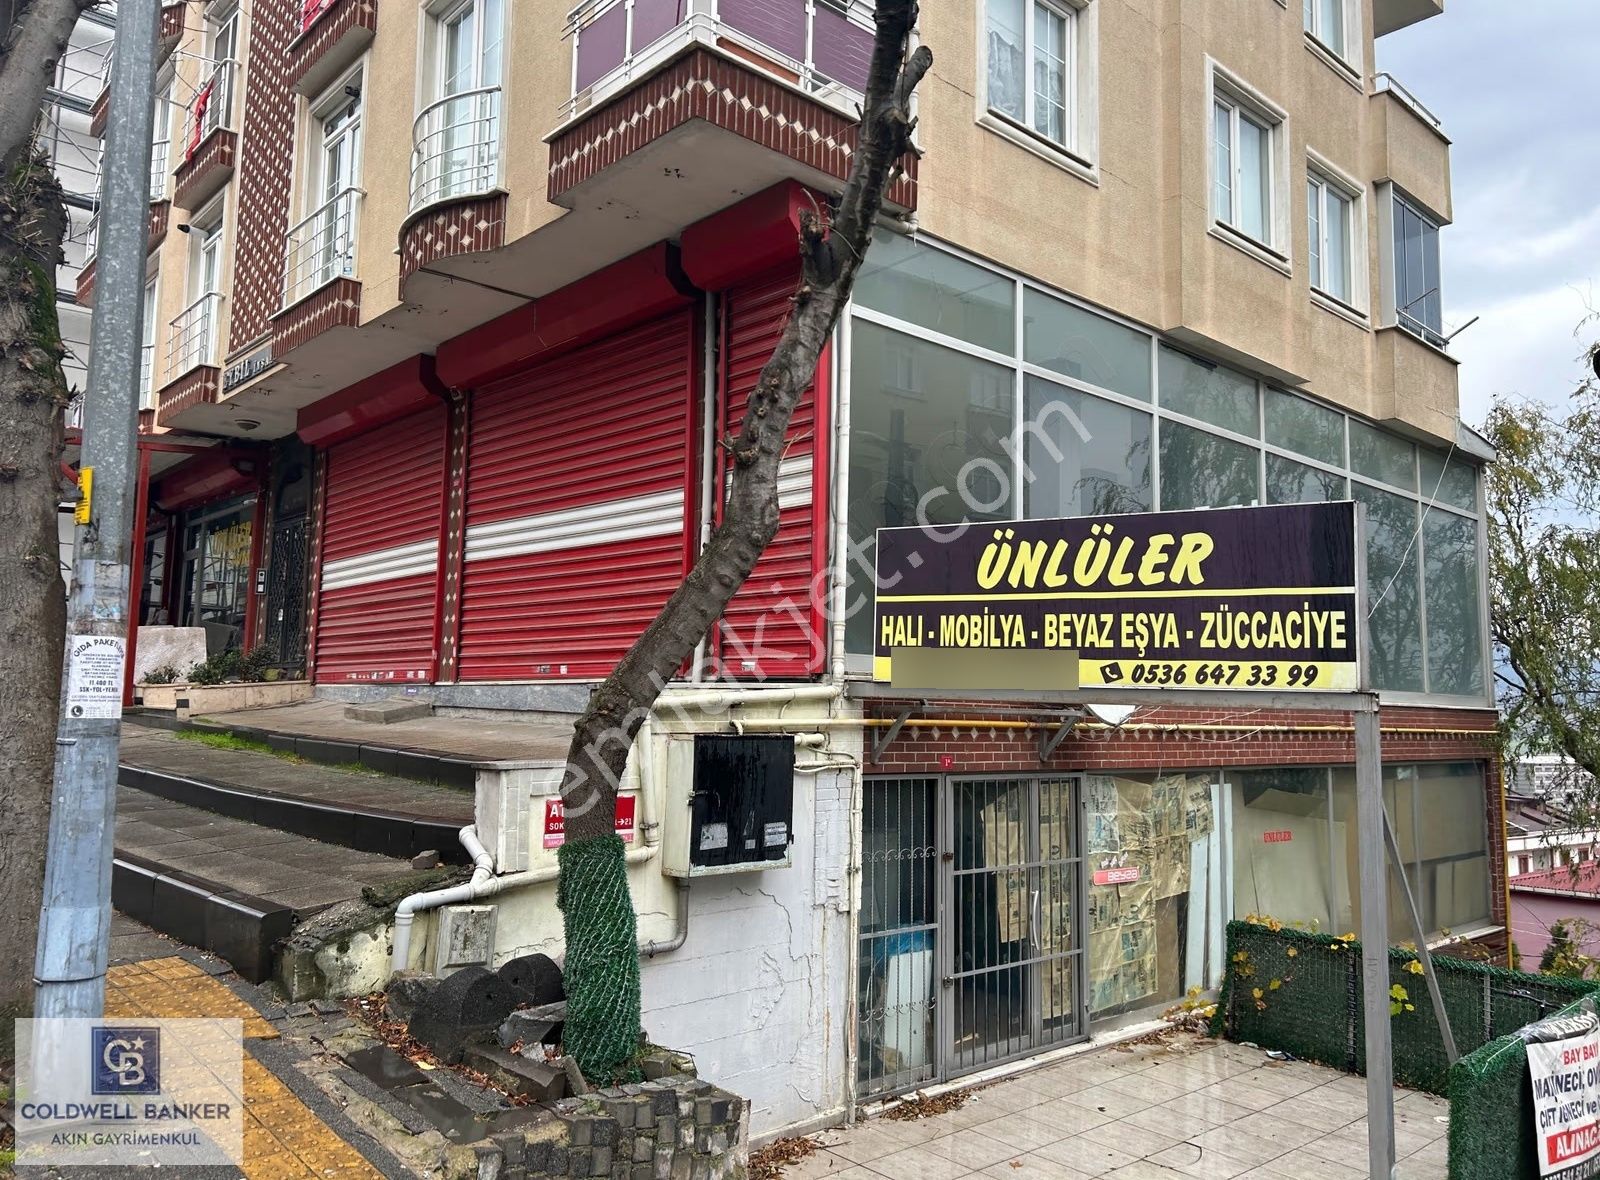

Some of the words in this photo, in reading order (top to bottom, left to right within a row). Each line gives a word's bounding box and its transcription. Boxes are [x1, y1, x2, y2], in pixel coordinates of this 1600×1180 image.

[976, 523, 1215, 590] ÜNLÜLER
[881, 614, 923, 647] HALI
[939, 606, 1026, 648] MOBİLYA
[1044, 613, 1114, 648] BEYAZ
[1121, 612, 1180, 658] EŞYA
[1200, 601, 1347, 650] ZÜCCACİYE
[74, 641, 92, 657] GIDA
[1131, 663, 1187, 685] 0536
[1195, 663, 1241, 685] 647
[1246, 664, 1278, 686] 33
[1287, 664, 1319, 687] 99
[1563, 1047, 1580, 1066] BAY
[1586, 1100, 1597, 1115] ve
